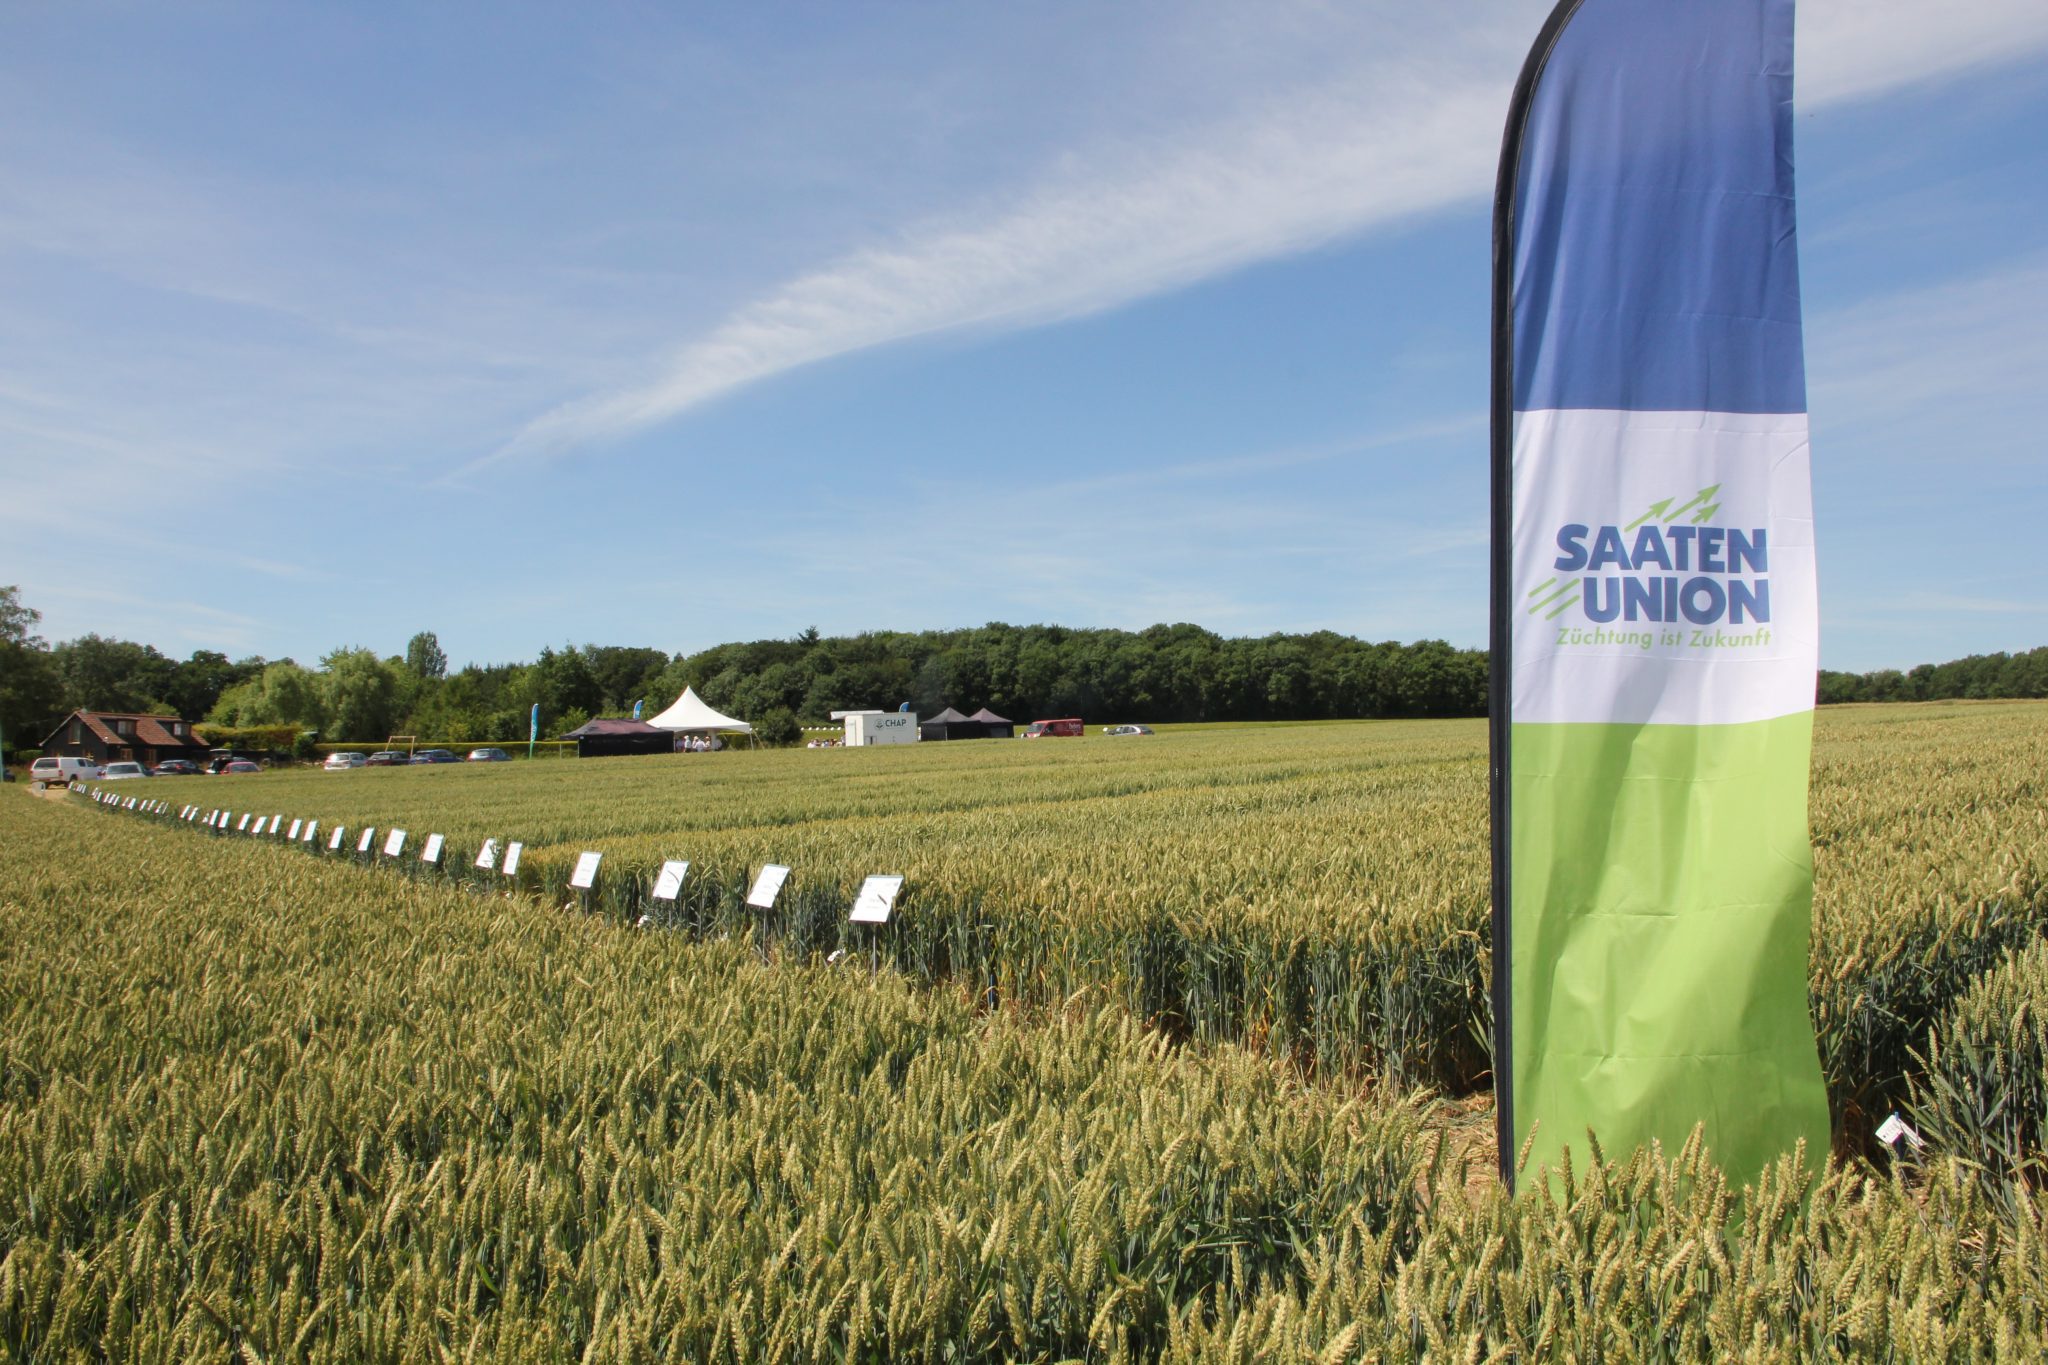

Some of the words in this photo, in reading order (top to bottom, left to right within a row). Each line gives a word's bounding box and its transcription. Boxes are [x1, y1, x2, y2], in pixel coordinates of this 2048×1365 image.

[1554, 523, 1768, 573] SAATEN
[1583, 576, 1770, 625] UNION
[1556, 627, 1653, 650] Züchtung
[1660, 628, 1682, 647] ist
[1688, 627, 1771, 648] Zukunft
[885, 719, 907, 727] CHAP
